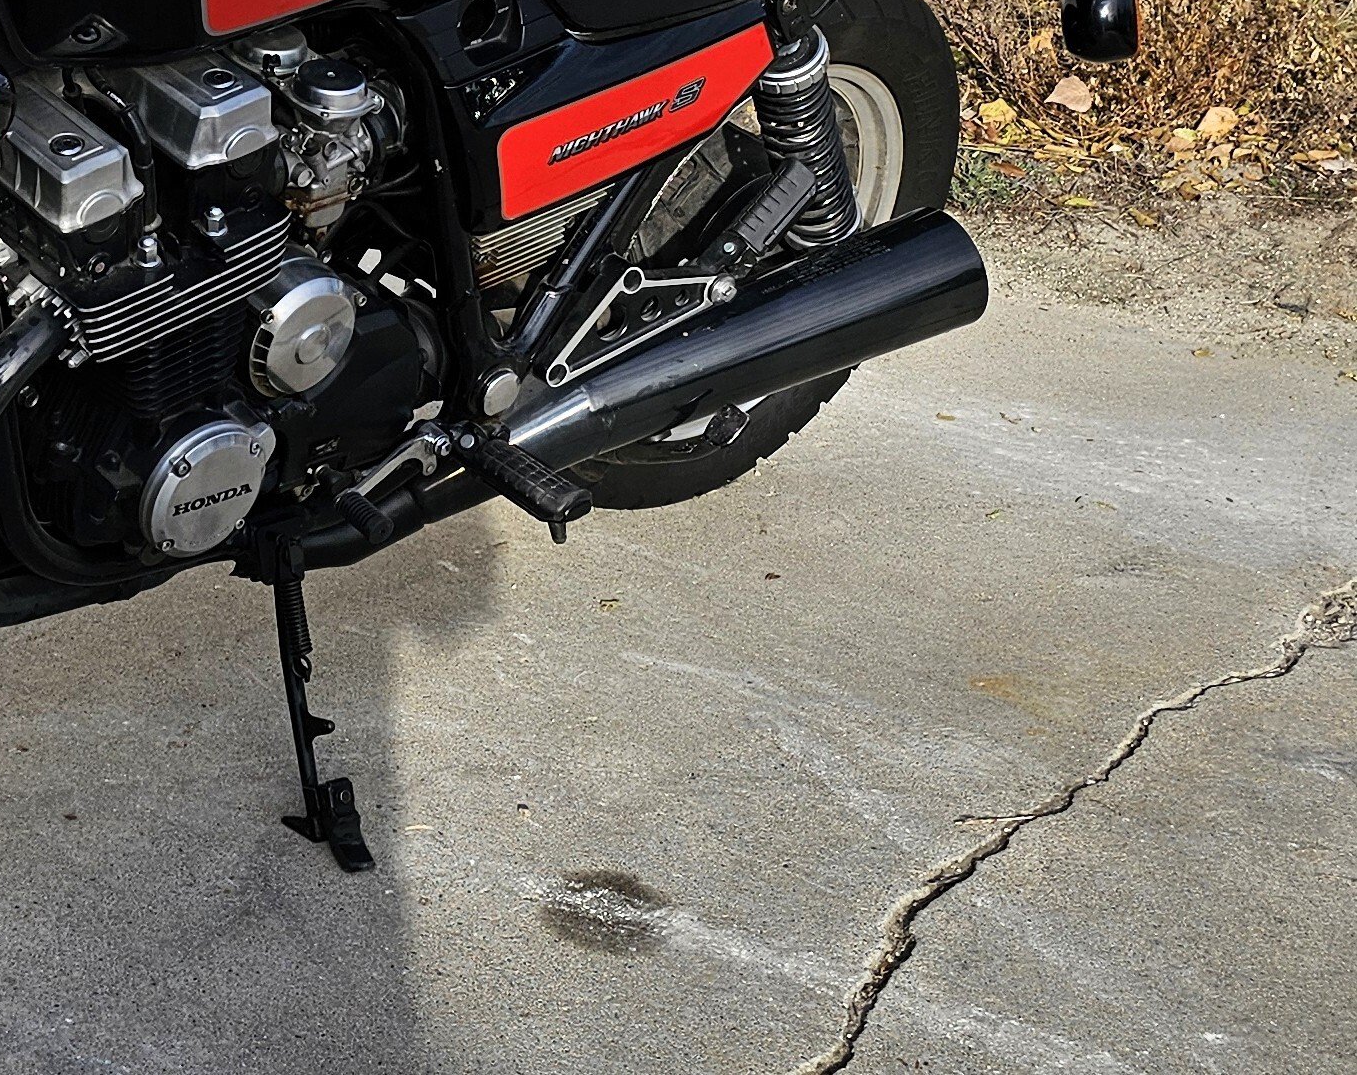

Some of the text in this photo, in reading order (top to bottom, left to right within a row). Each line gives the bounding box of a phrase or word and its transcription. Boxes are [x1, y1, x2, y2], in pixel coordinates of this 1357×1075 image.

[548, 76, 706, 166] NIGHTHAWK S
[172, 483, 253, 517] HONDA
